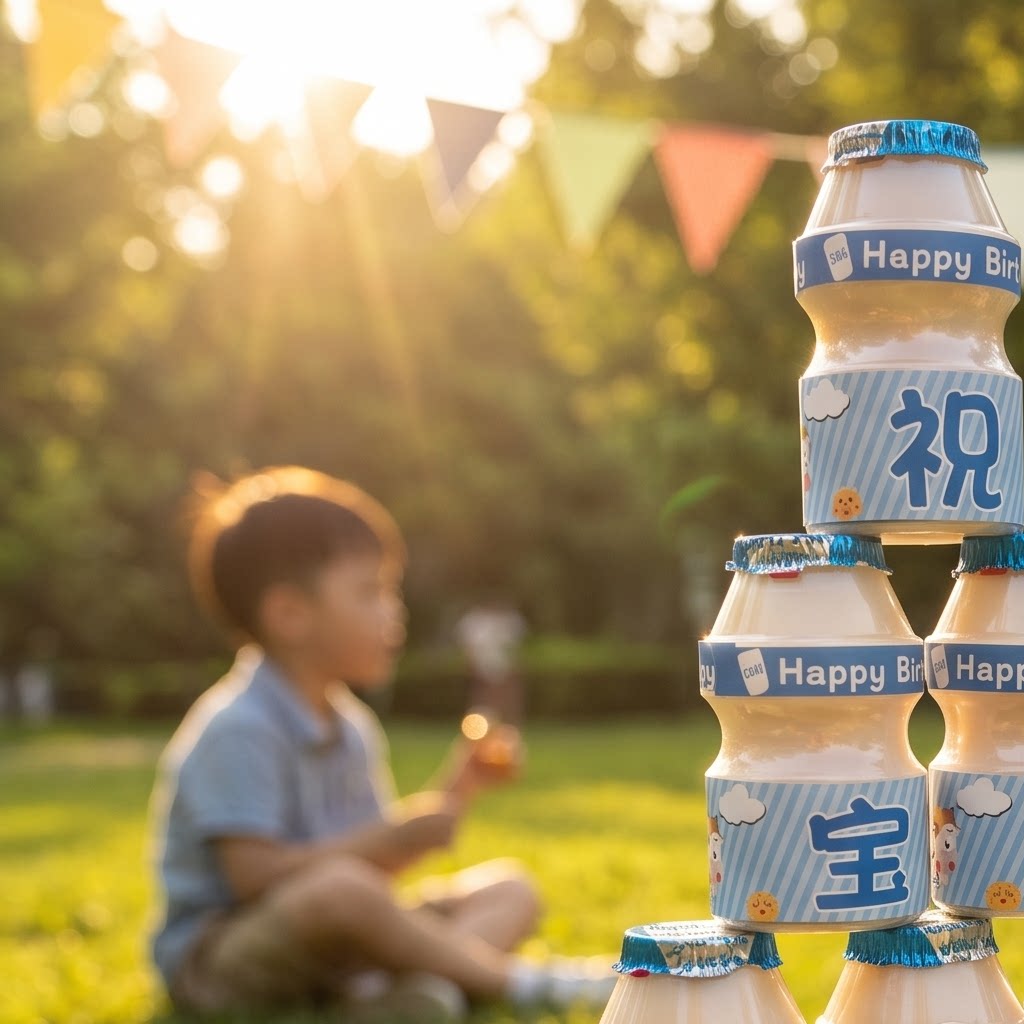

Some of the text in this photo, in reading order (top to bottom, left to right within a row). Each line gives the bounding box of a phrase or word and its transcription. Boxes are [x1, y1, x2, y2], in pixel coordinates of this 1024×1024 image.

[863, 240, 971, 279] Happy
[890, 387, 1002, 511] 祝
[779, 657, 885, 693] Happy
[809, 797, 909, 912] 宝
